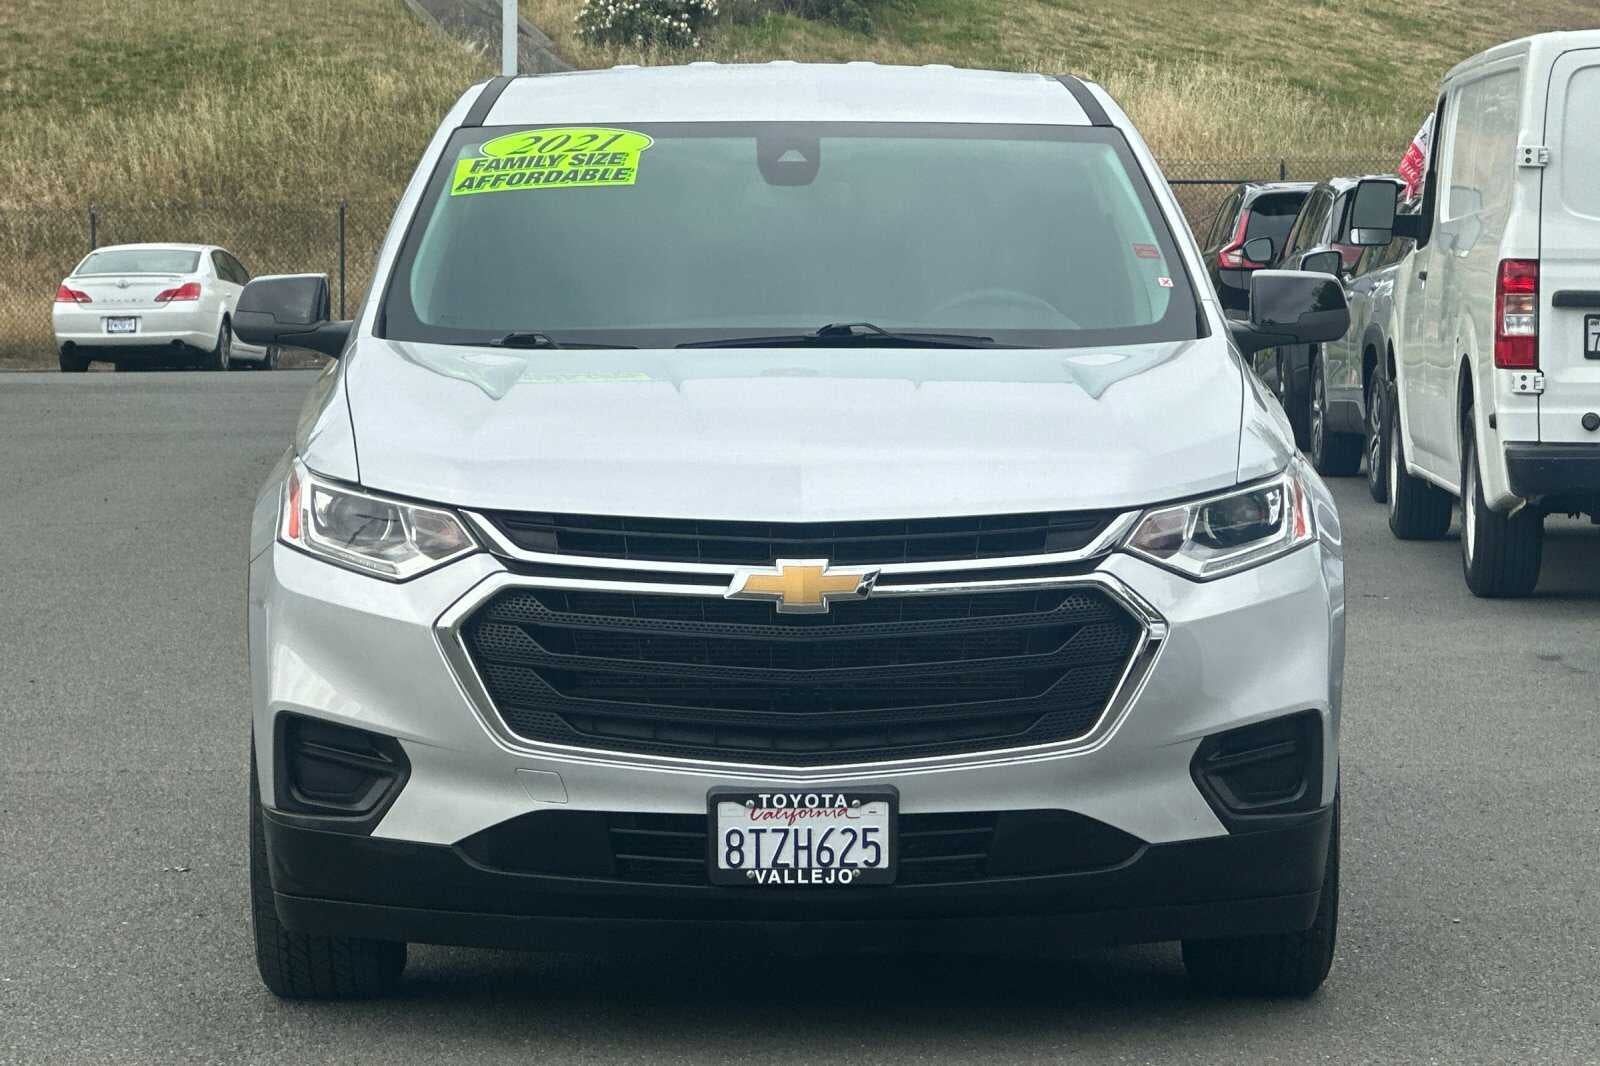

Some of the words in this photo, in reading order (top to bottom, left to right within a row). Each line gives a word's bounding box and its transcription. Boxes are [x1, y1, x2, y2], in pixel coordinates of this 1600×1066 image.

[506, 133, 626, 154] 2021
[470, 153, 568, 174] FAMILY
[568, 151, 630, 167] SIZE
[455, 167, 635, 192] AFFORDABLE
[758, 794, 847, 808] TOYOTA
[749, 806, 861, 826] California
[725, 827, 881, 868] 8TZH625
[754, 869, 853, 884] VALLEJO
